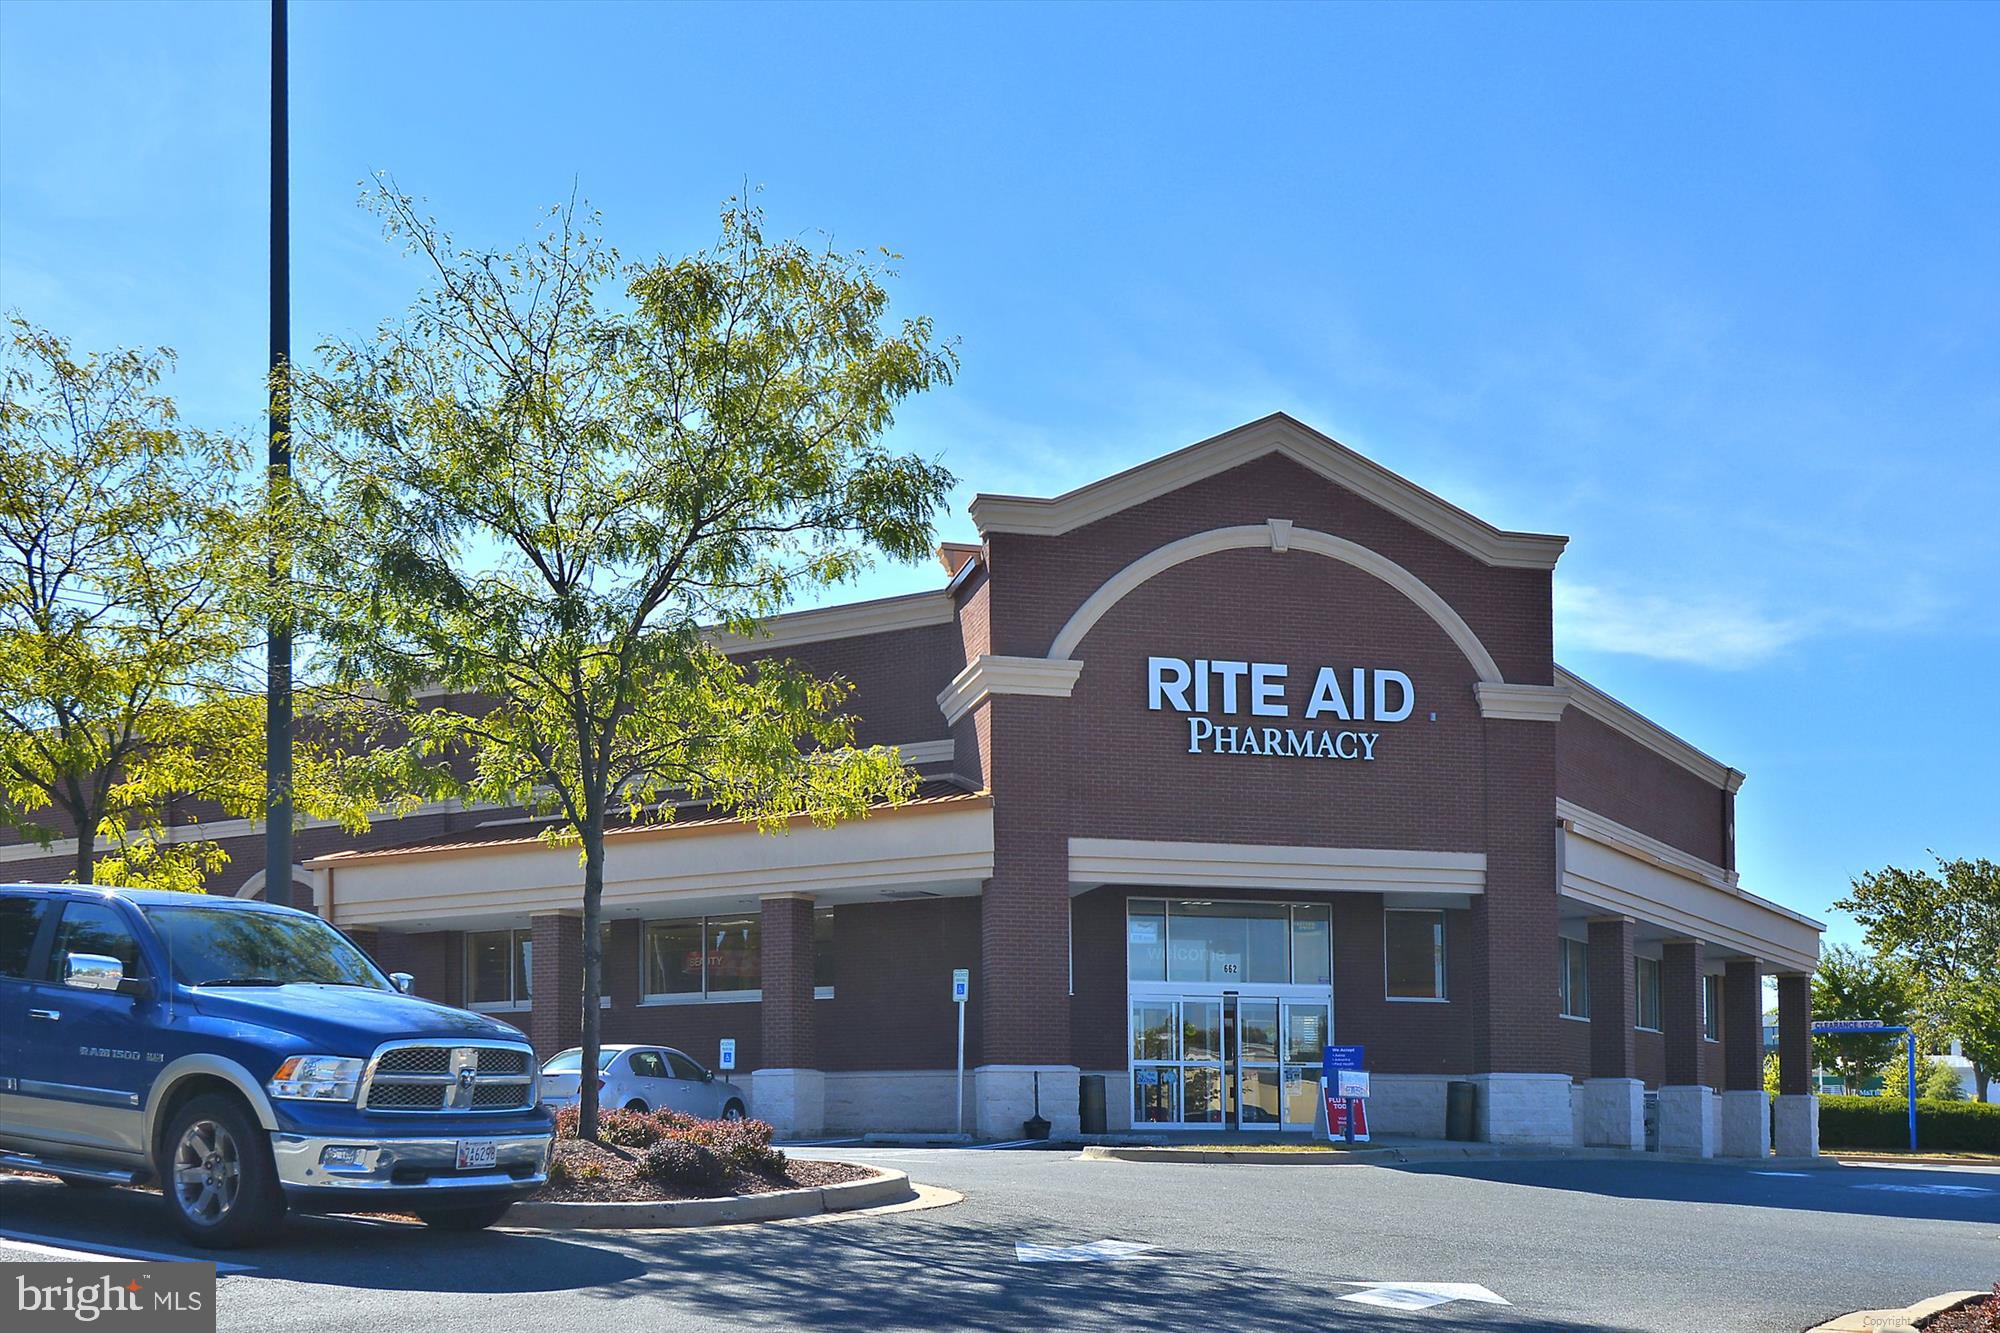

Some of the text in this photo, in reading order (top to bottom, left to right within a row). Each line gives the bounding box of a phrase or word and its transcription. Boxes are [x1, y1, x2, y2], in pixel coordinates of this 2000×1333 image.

[1148, 656, 1416, 722] RITE AID
[1187, 716, 1380, 761] PHARMACY
[1223, 964, 1238, 974] 662
[1815, 1021, 1859, 1029] CLEARANCE
[80, 1046, 111, 1058] RAM
[111, 1049, 141, 1061] 1500
